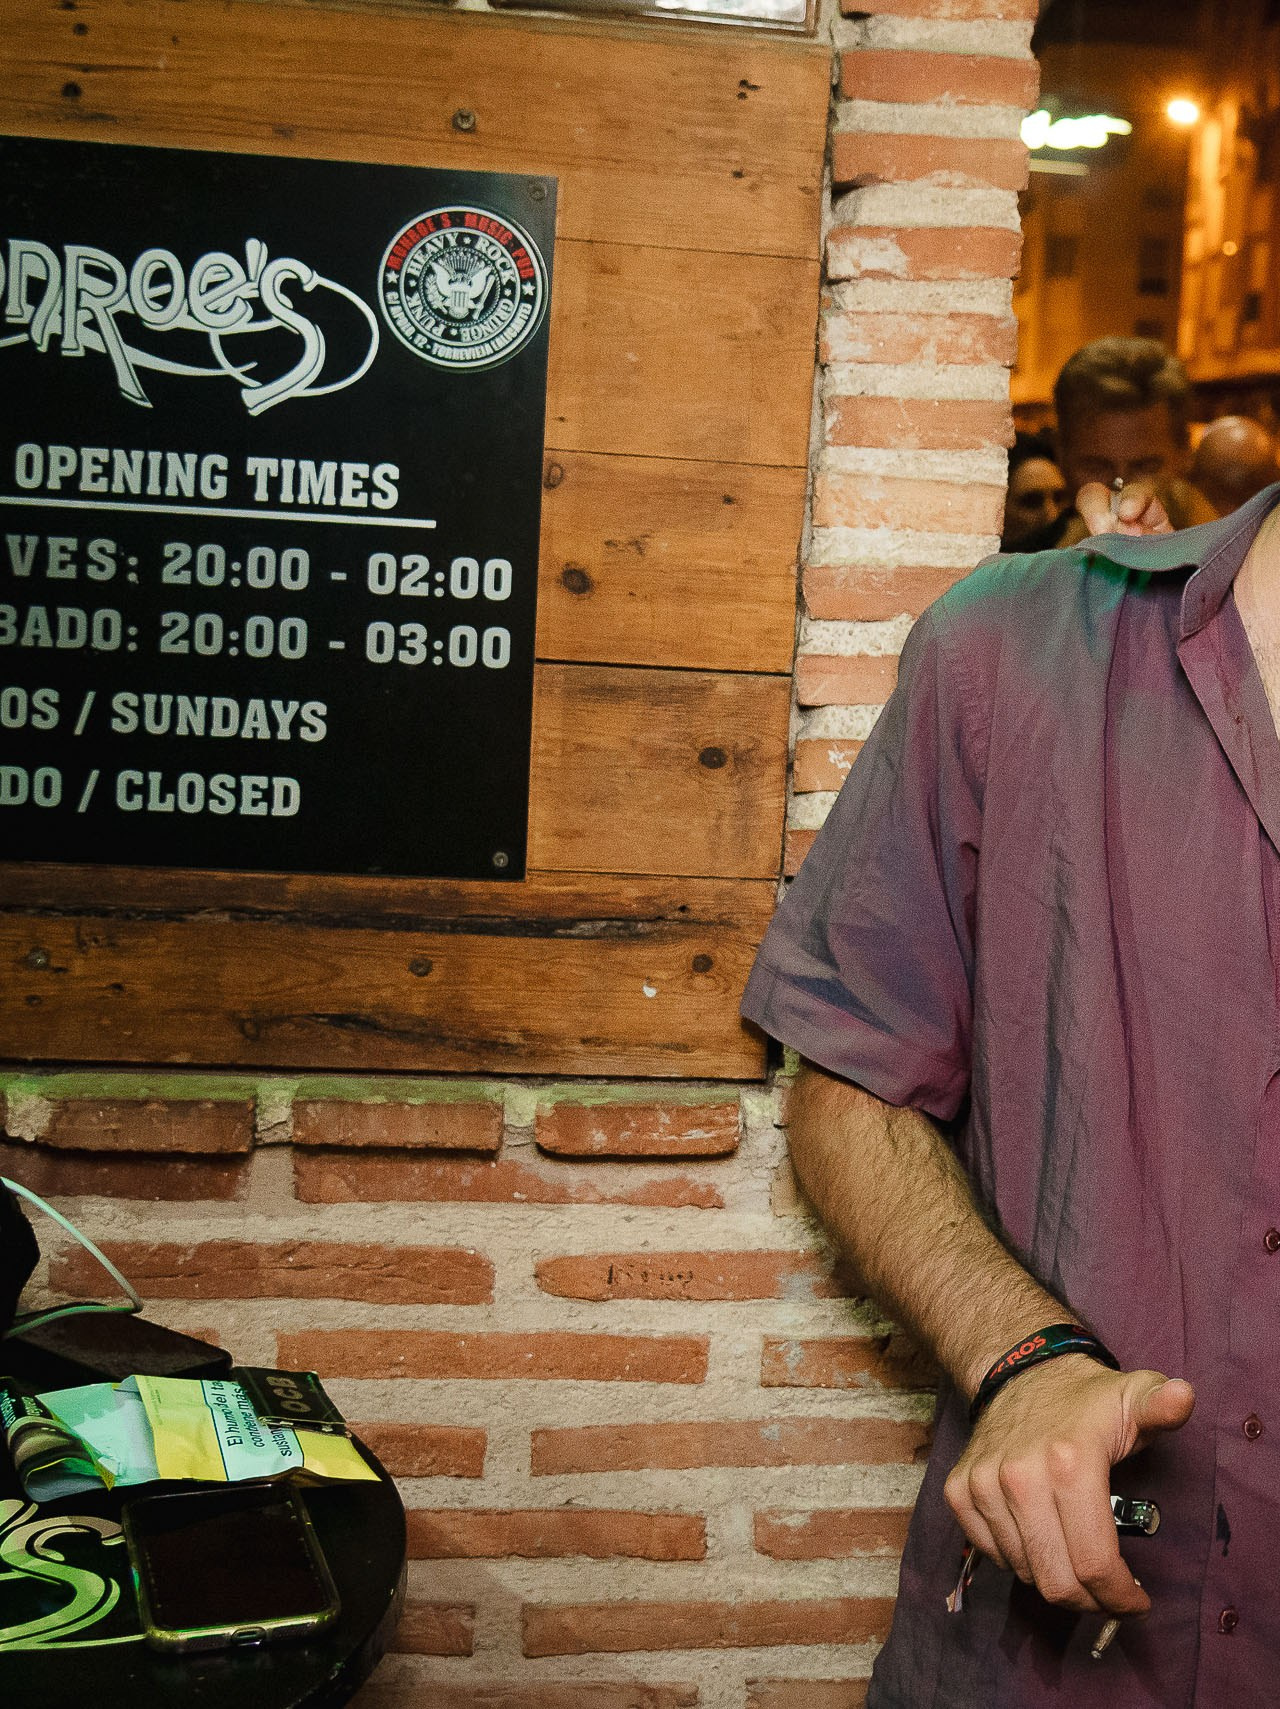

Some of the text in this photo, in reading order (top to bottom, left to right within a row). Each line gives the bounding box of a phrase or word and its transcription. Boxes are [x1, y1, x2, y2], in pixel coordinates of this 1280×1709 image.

[407, 233, 517, 285] HEAVY ROCK
[464, 213, 513, 246] MUSIC
[512, 248, 535, 279] PUB
[406, 292, 514, 343] PUNK GRUNGE
[15, 443, 400, 509] OPENING TIMES
[6, 534, 513, 601] VES: 20:00 - 02:00
[160, 611, 309, 660] 20:00
[328, 639, 346, 650] -
[366, 621, 511, 669] 03:00
[0, 686, 328, 742] OS / SUNDAYS
[77, 769, 100, 813] /
[116, 770, 301, 817] CLOSED
[212, 1393, 229, 1408] del
[231, 1387, 265, 1448] contiene más
[265, 1376, 312, 1413] OCB
[222, 1409, 240, 1434] humo
[226, 1435, 244, 1447] El
